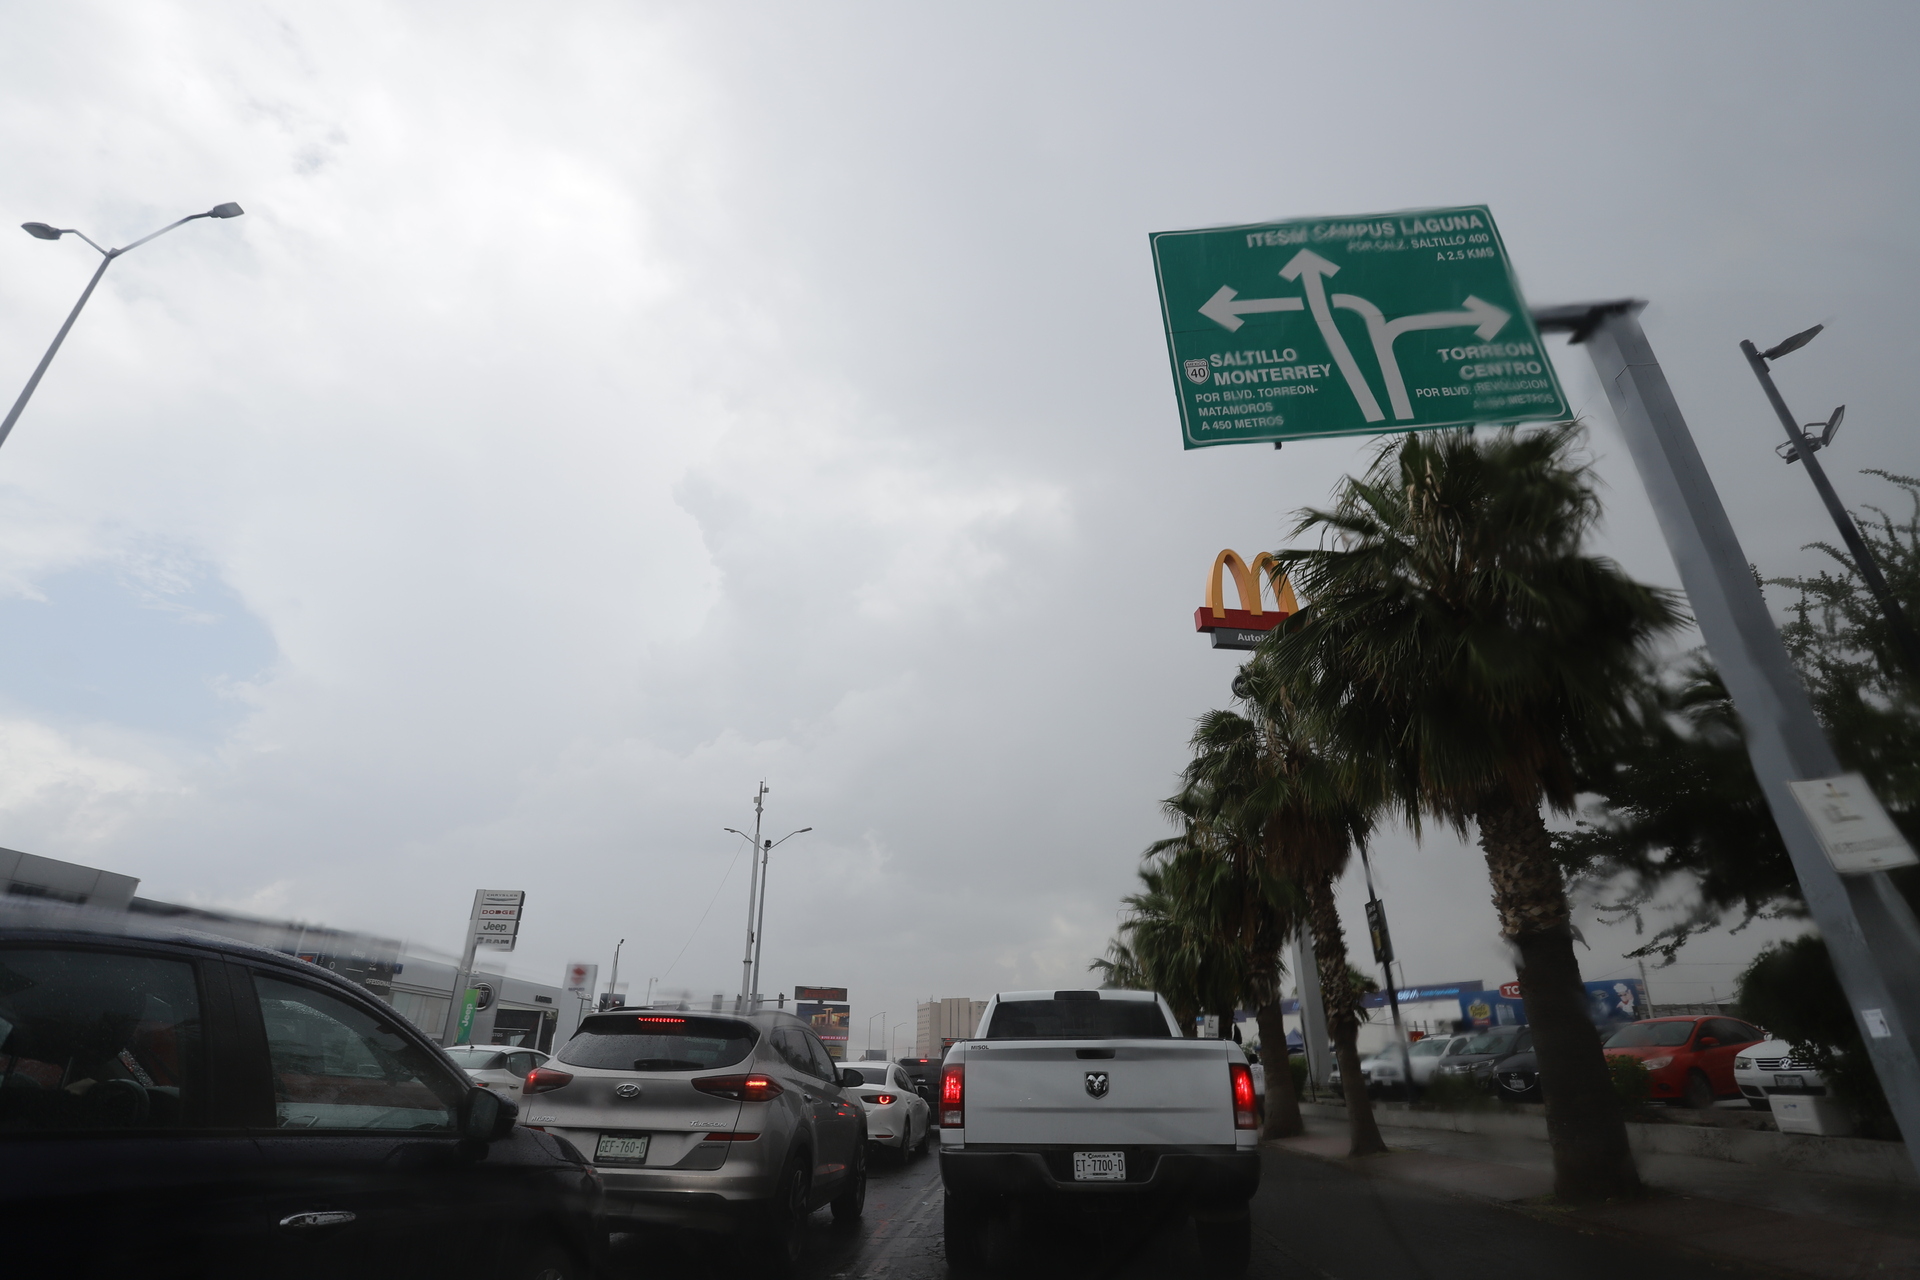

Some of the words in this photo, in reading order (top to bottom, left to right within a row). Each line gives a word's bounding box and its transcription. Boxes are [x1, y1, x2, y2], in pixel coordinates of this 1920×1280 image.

[1309, 220, 1396, 241] CAMPUS
[1400, 214, 1484, 236] LAGUNA
[1411, 234, 1465, 249] SALTILLO
[1469, 232, 1490, 244] 400
[1437, 252, 1446, 262] A
[1448, 250, 1464, 260] 2.5
[1467, 246, 1495, 258] KMS
[1209, 347, 1297, 367] SALTILLO
[1436, 342, 1535, 363] TORREON
[1190, 367, 1206, 378] 40
[1213, 363, 1331, 386] MONTERREY
[1459, 360, 1542, 380] CENTRO
[1195, 393, 1220, 403] POR
[1223, 389, 1256, 401] BLVD.
[1257, 384, 1319, 398] TORREON-
[1416, 387, 1440, 398] POR
[1441, 386, 1472, 397] BLVD.
[1198, 402, 1274, 417] MATAMOROS
[1201, 421, 1211, 431] A
[1212, 420, 1232, 430] 450
[1234, 415, 1284, 429] METROS
[483, 921, 507, 932] Jeep
[461, 1003, 473, 1027] Jeep
[1076, 1159, 1124, 1172] ET-7700-D
